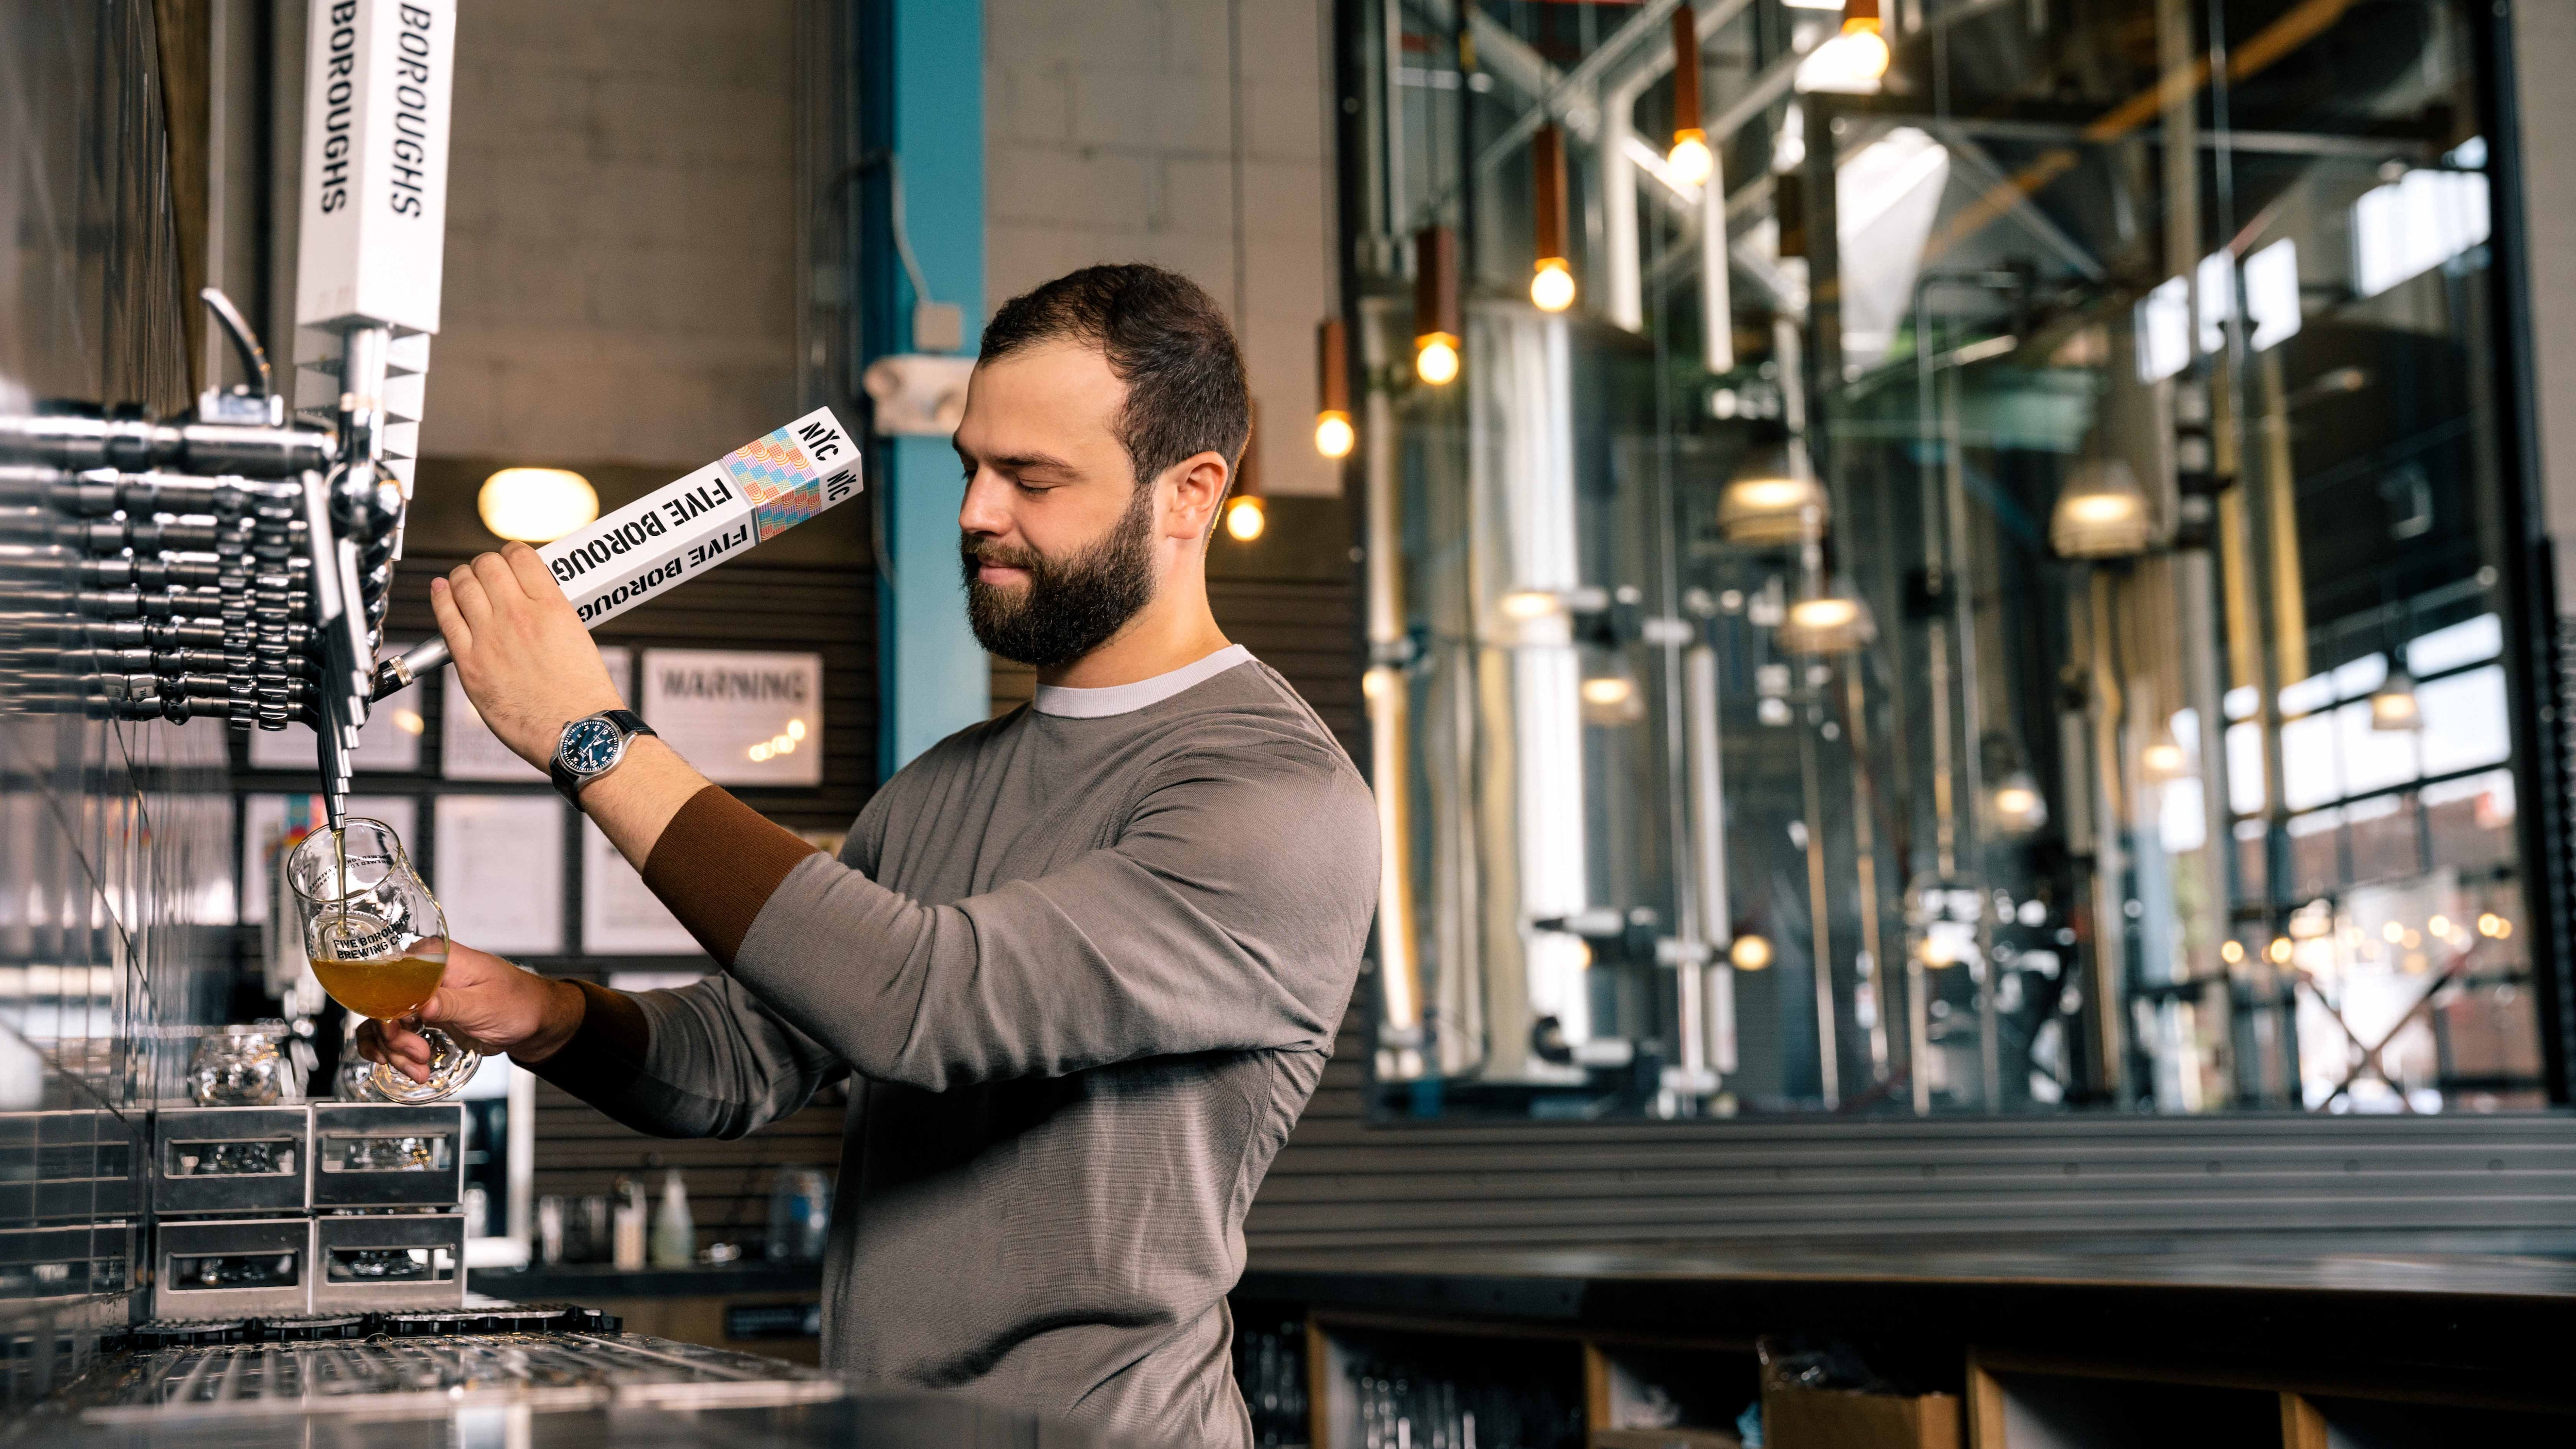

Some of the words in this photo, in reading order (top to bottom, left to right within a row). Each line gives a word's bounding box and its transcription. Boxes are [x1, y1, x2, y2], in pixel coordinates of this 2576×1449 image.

[321, 0, 357, 214] BOROUGHS
[391, 4, 431, 218] BOROUGHS
[798, 421, 840, 461] NYC
[662, 478, 733, 526] FIVE
[827, 469, 857, 501] NYC
[546, 511, 667, 586] BOROUG
[688, 524, 748, 568] FIVE
[333, 939, 358, 949] FIVE
[360, 913, 410, 947] BOROUGHS
[336, 942, 388, 959] BREWING
